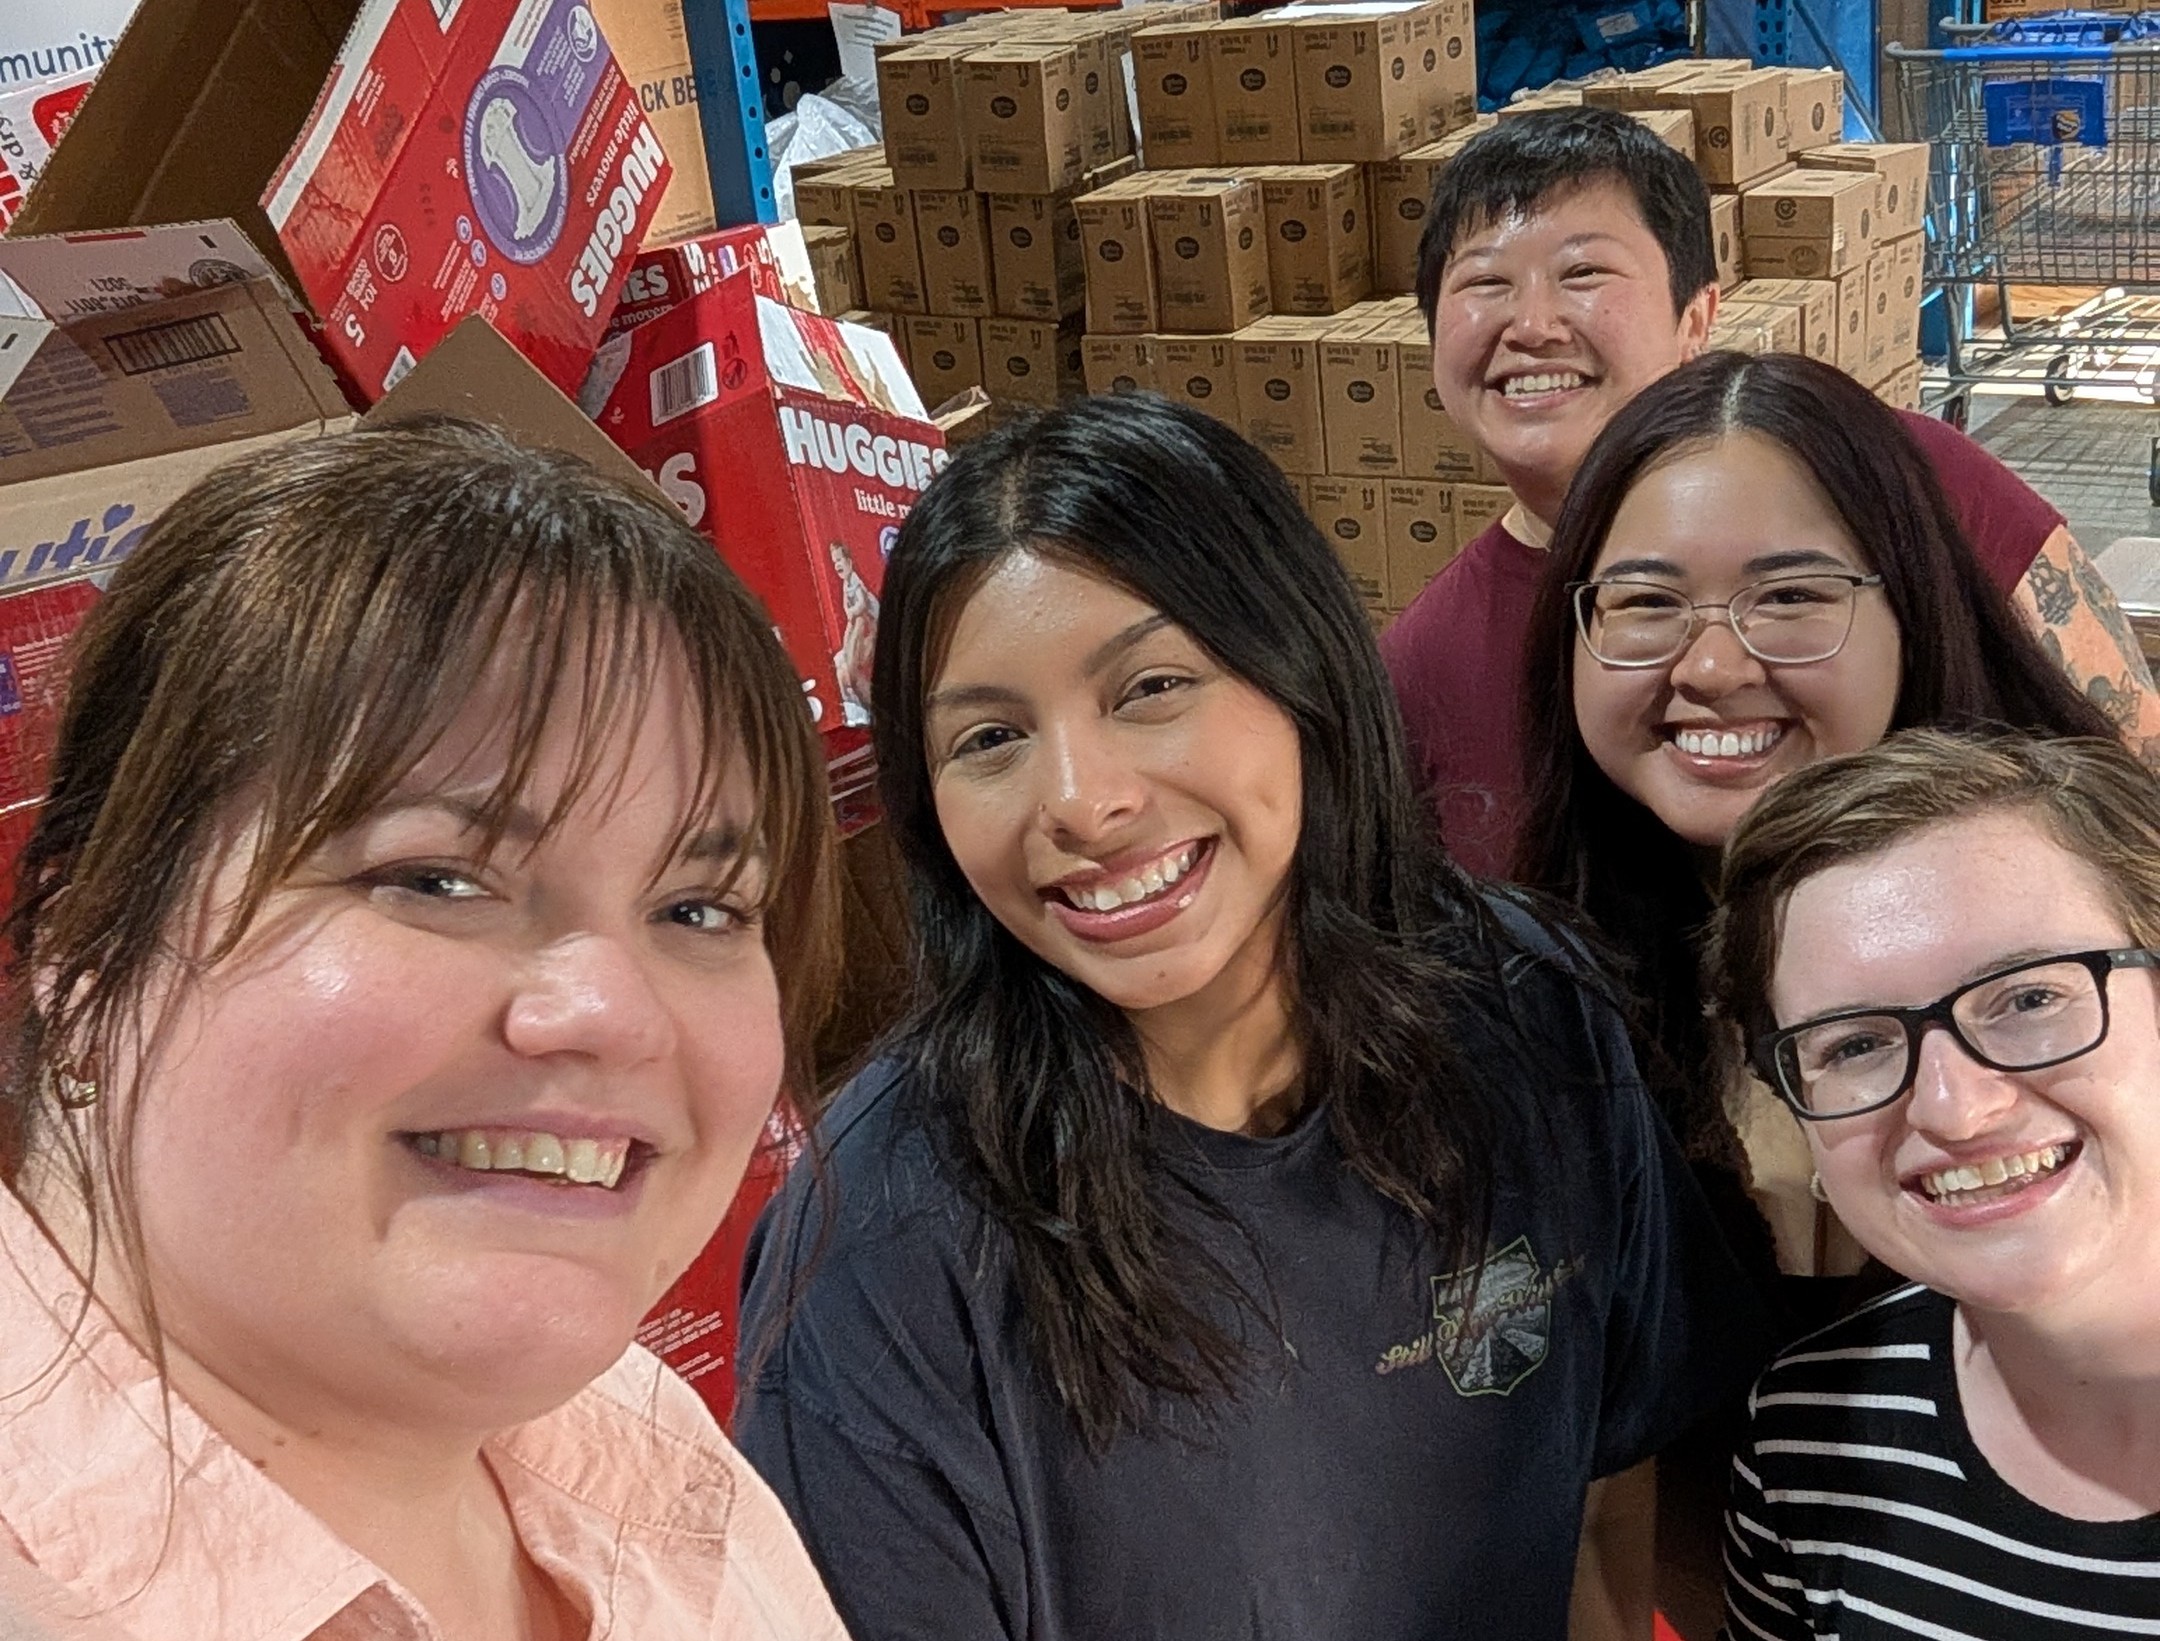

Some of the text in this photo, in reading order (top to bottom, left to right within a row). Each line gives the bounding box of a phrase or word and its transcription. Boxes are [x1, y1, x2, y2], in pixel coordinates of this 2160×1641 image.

[0, 32, 117, 83] munit
[586, 99, 640, 207] little movers
[571, 120, 664, 318] HUGGIES
[345, 314, 365, 347] 5
[854, 487, 897, 519] little
